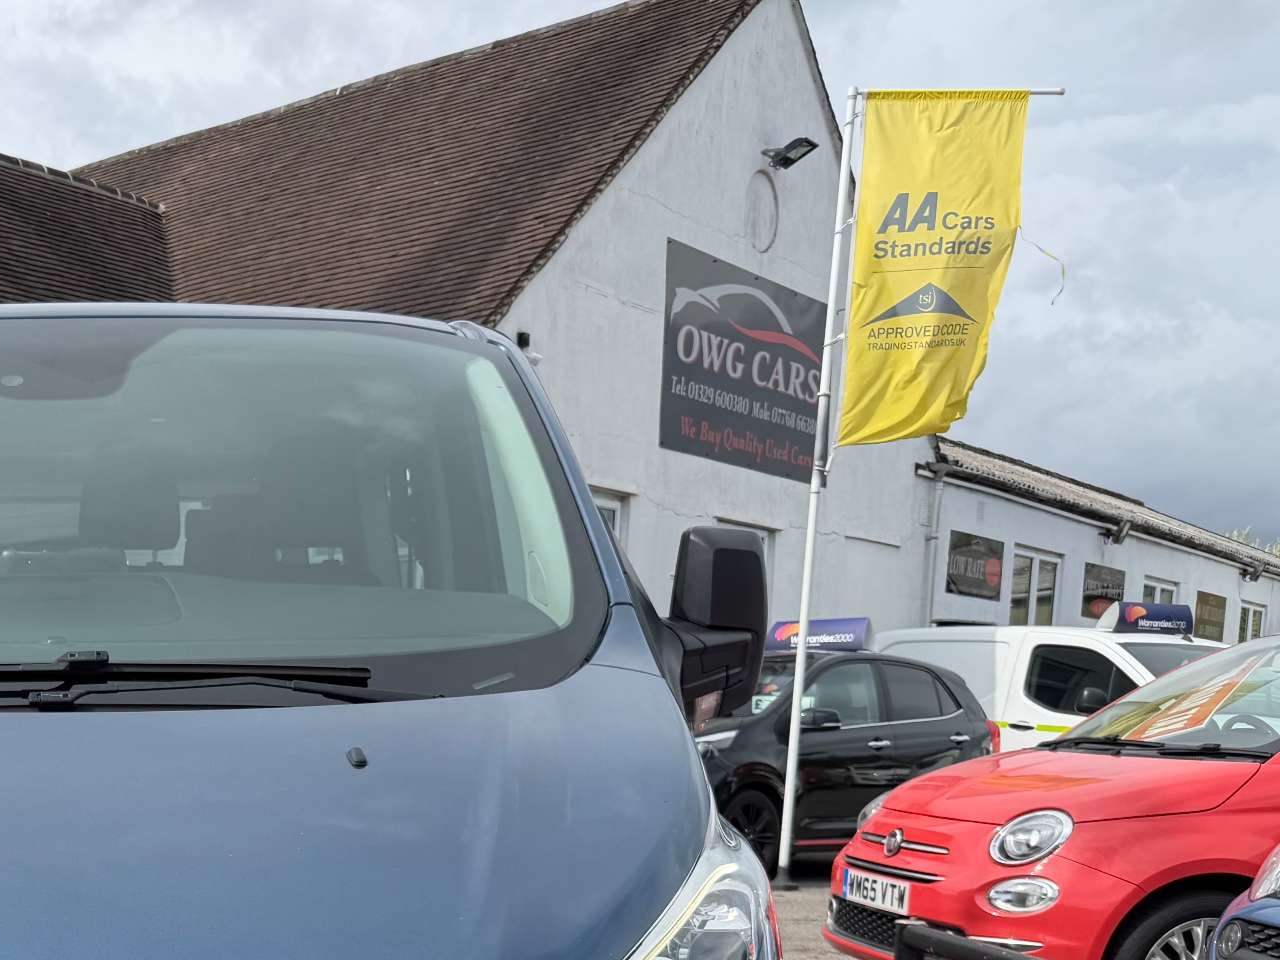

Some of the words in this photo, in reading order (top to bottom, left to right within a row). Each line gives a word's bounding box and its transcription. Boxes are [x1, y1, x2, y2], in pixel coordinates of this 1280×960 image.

[876, 191, 939, 235] AA
[941, 211, 996, 230] Cars
[873, 236, 993, 260] Standards
[676, 324, 745, 379] OWG
[751, 350, 821, 405] CARS
[671, 375, 687, 397] Tel:
[687, 381, 714, 405] 01329
[714, 389, 749, 415] 600380
[680, 415, 696, 439] We
[699, 420, 721, 452] Buy
[723, 427, 764, 463] Quality
[765, 438, 789, 461] Used
[848, 873, 878, 902] WM65
[880, 880, 907, 910] VTW
